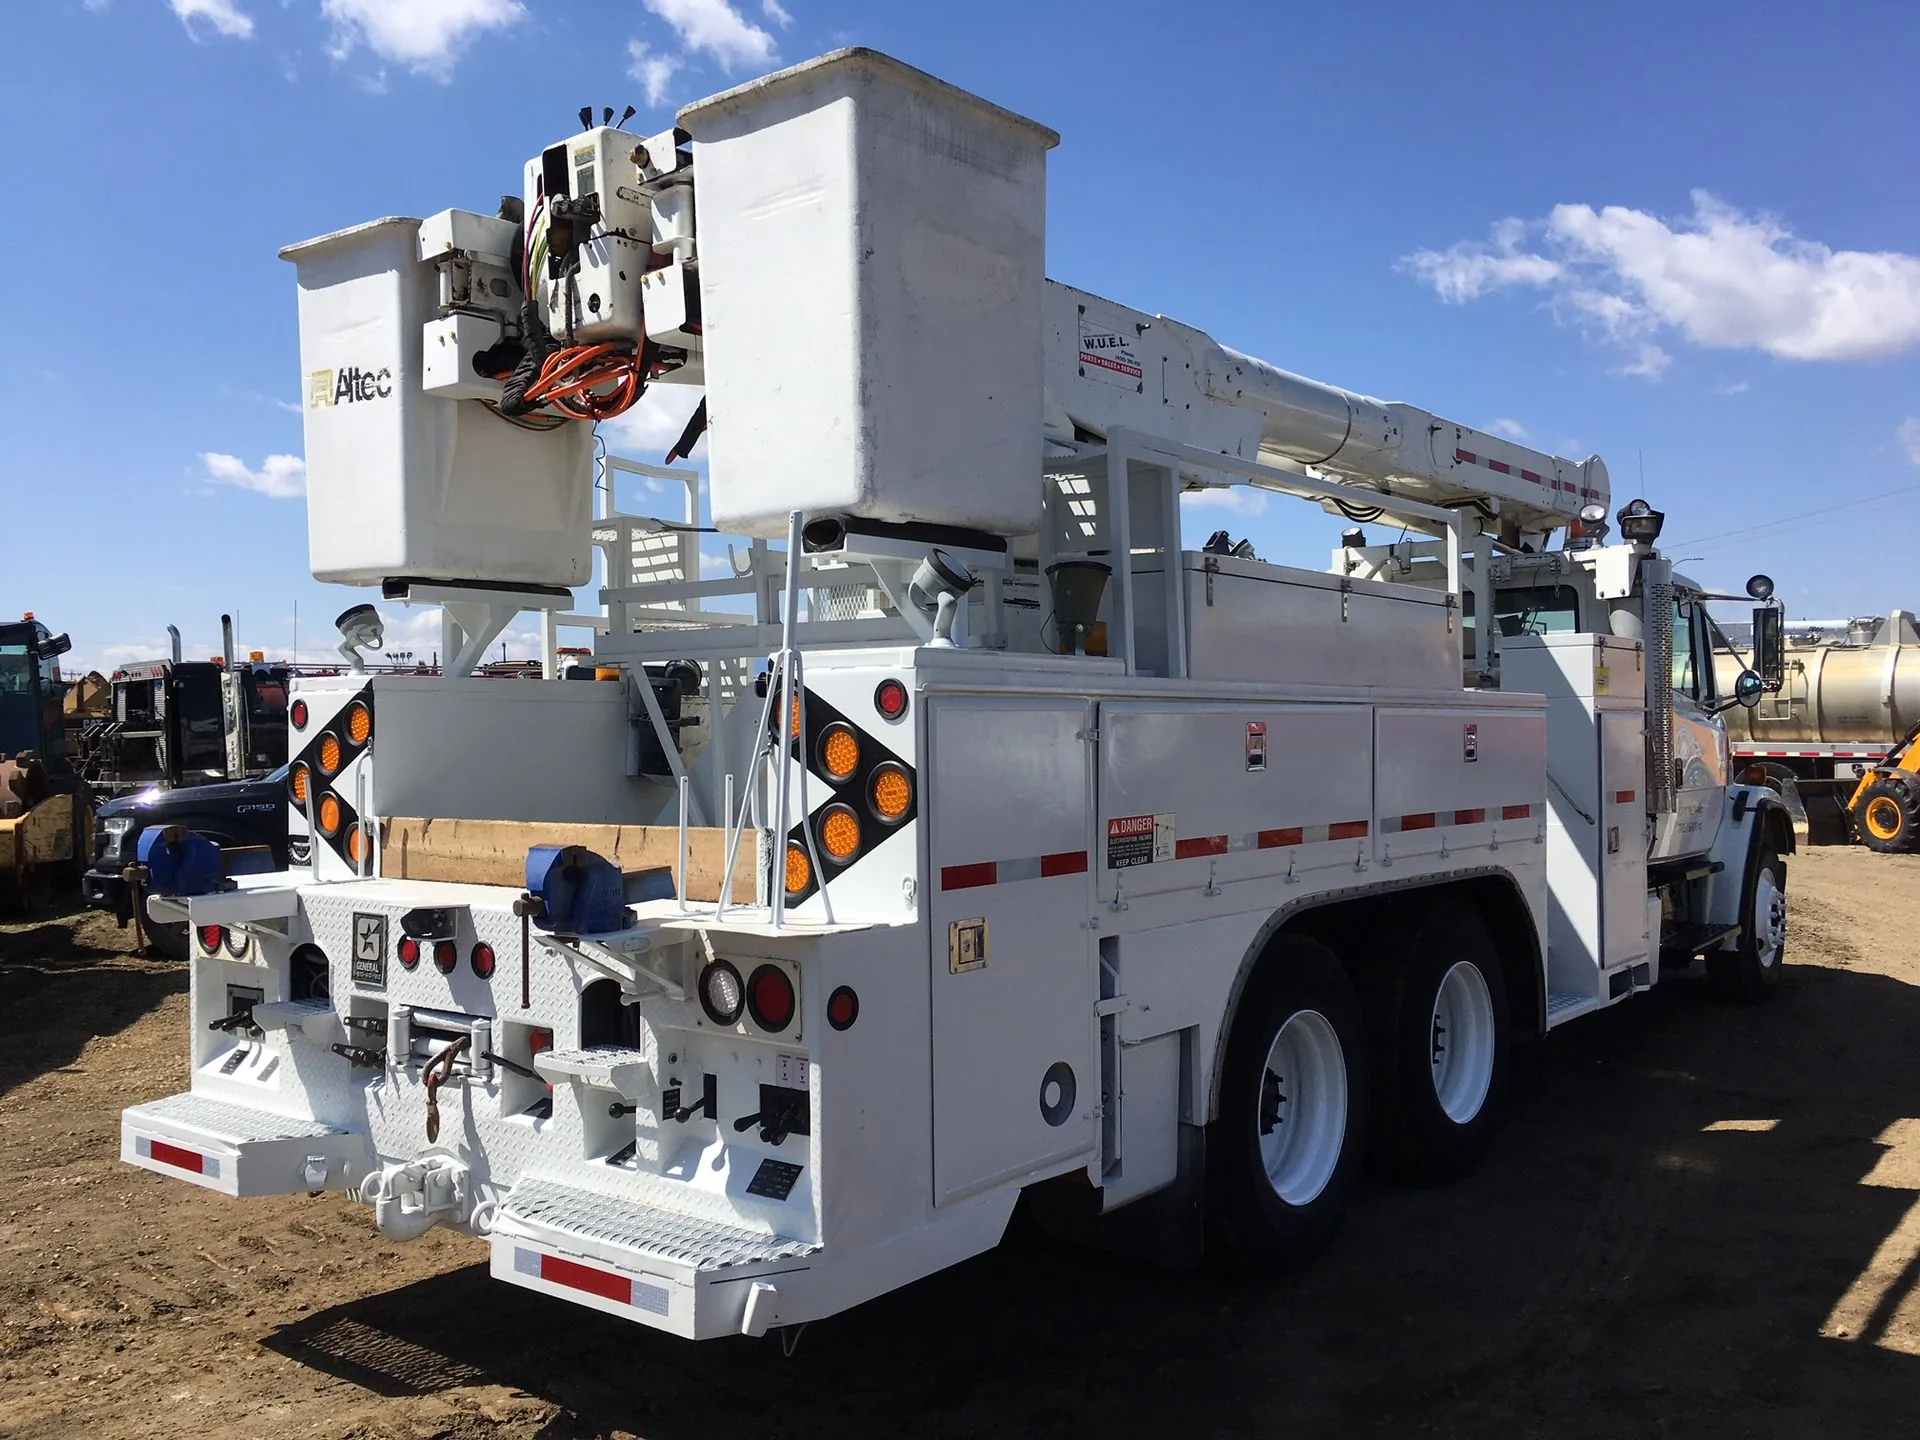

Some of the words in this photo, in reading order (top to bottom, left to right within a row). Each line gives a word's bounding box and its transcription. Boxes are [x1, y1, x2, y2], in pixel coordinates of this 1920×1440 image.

[1083, 337, 1130, 350] W.U.E.L.
[1080, 353, 1097, 364] PARTS
[1101, 359, 1117, 370] SALES
[1120, 365, 1141, 377] SERVICE
[334, 366, 392, 405] Altec
[1121, 817, 1153, 833] DANGER
[1115, 858, 1130, 867] KEEP
[1130, 856, 1148, 865] CLEAR
[356, 961, 379, 973] GENERAL
